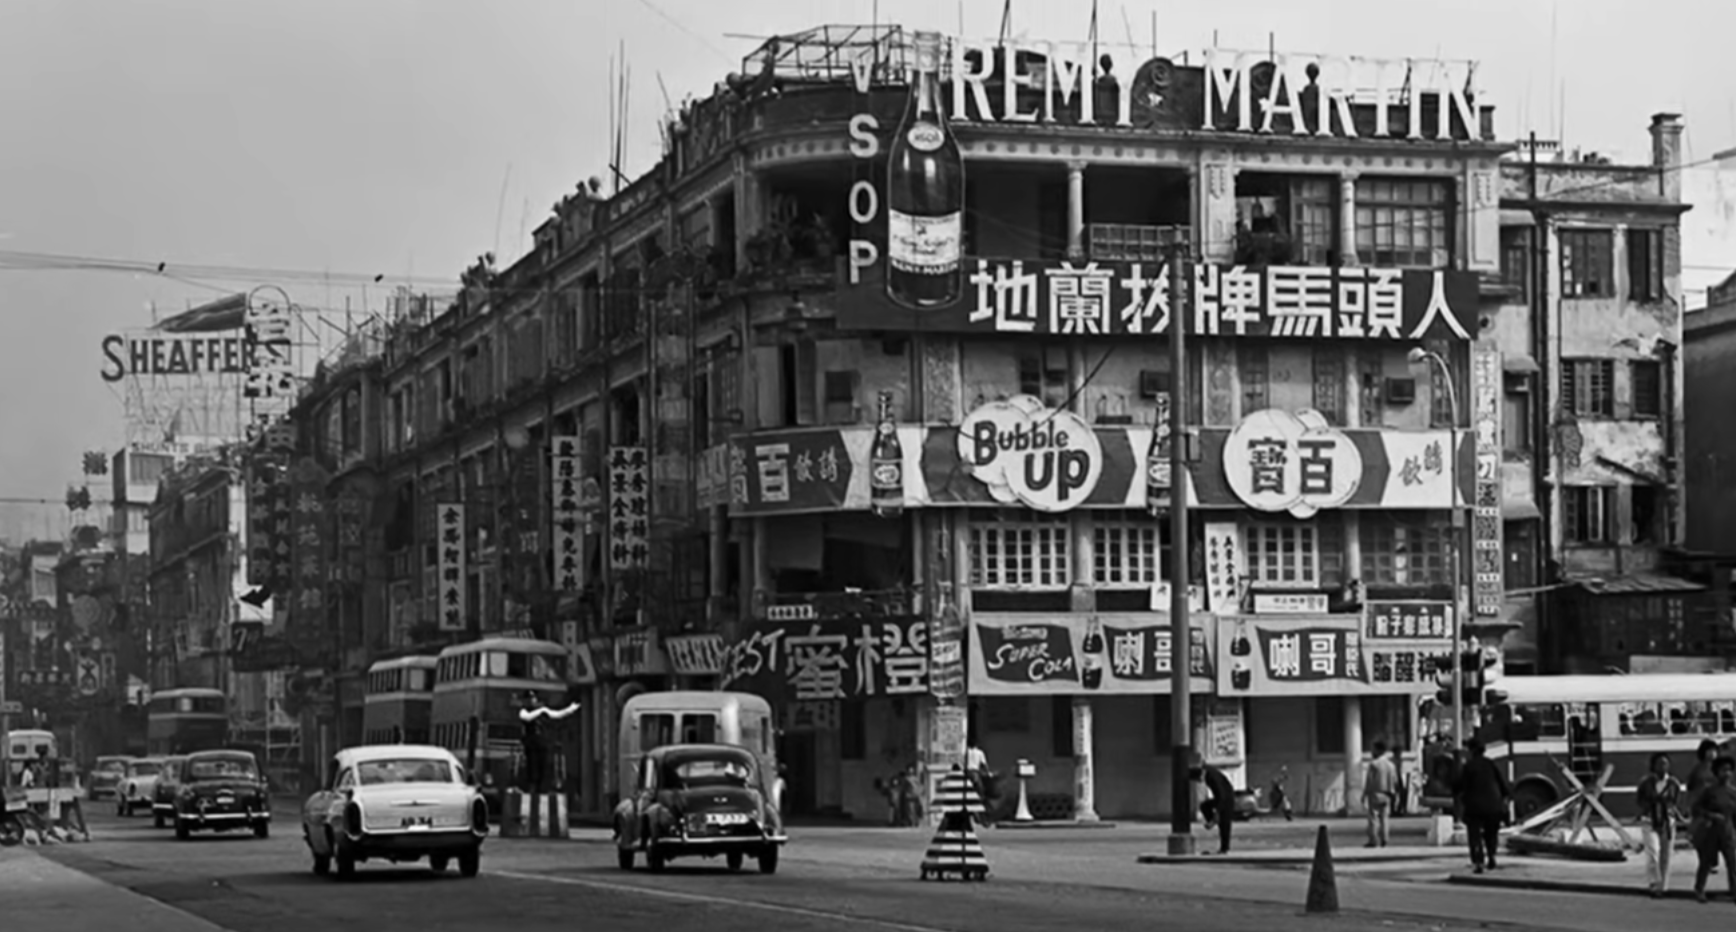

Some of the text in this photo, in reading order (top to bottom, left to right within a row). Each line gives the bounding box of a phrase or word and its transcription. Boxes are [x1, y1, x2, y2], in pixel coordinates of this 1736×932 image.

[950, 40, 1484, 142] REMY MARTIN
[974, 419, 1069, 466] Bubble
